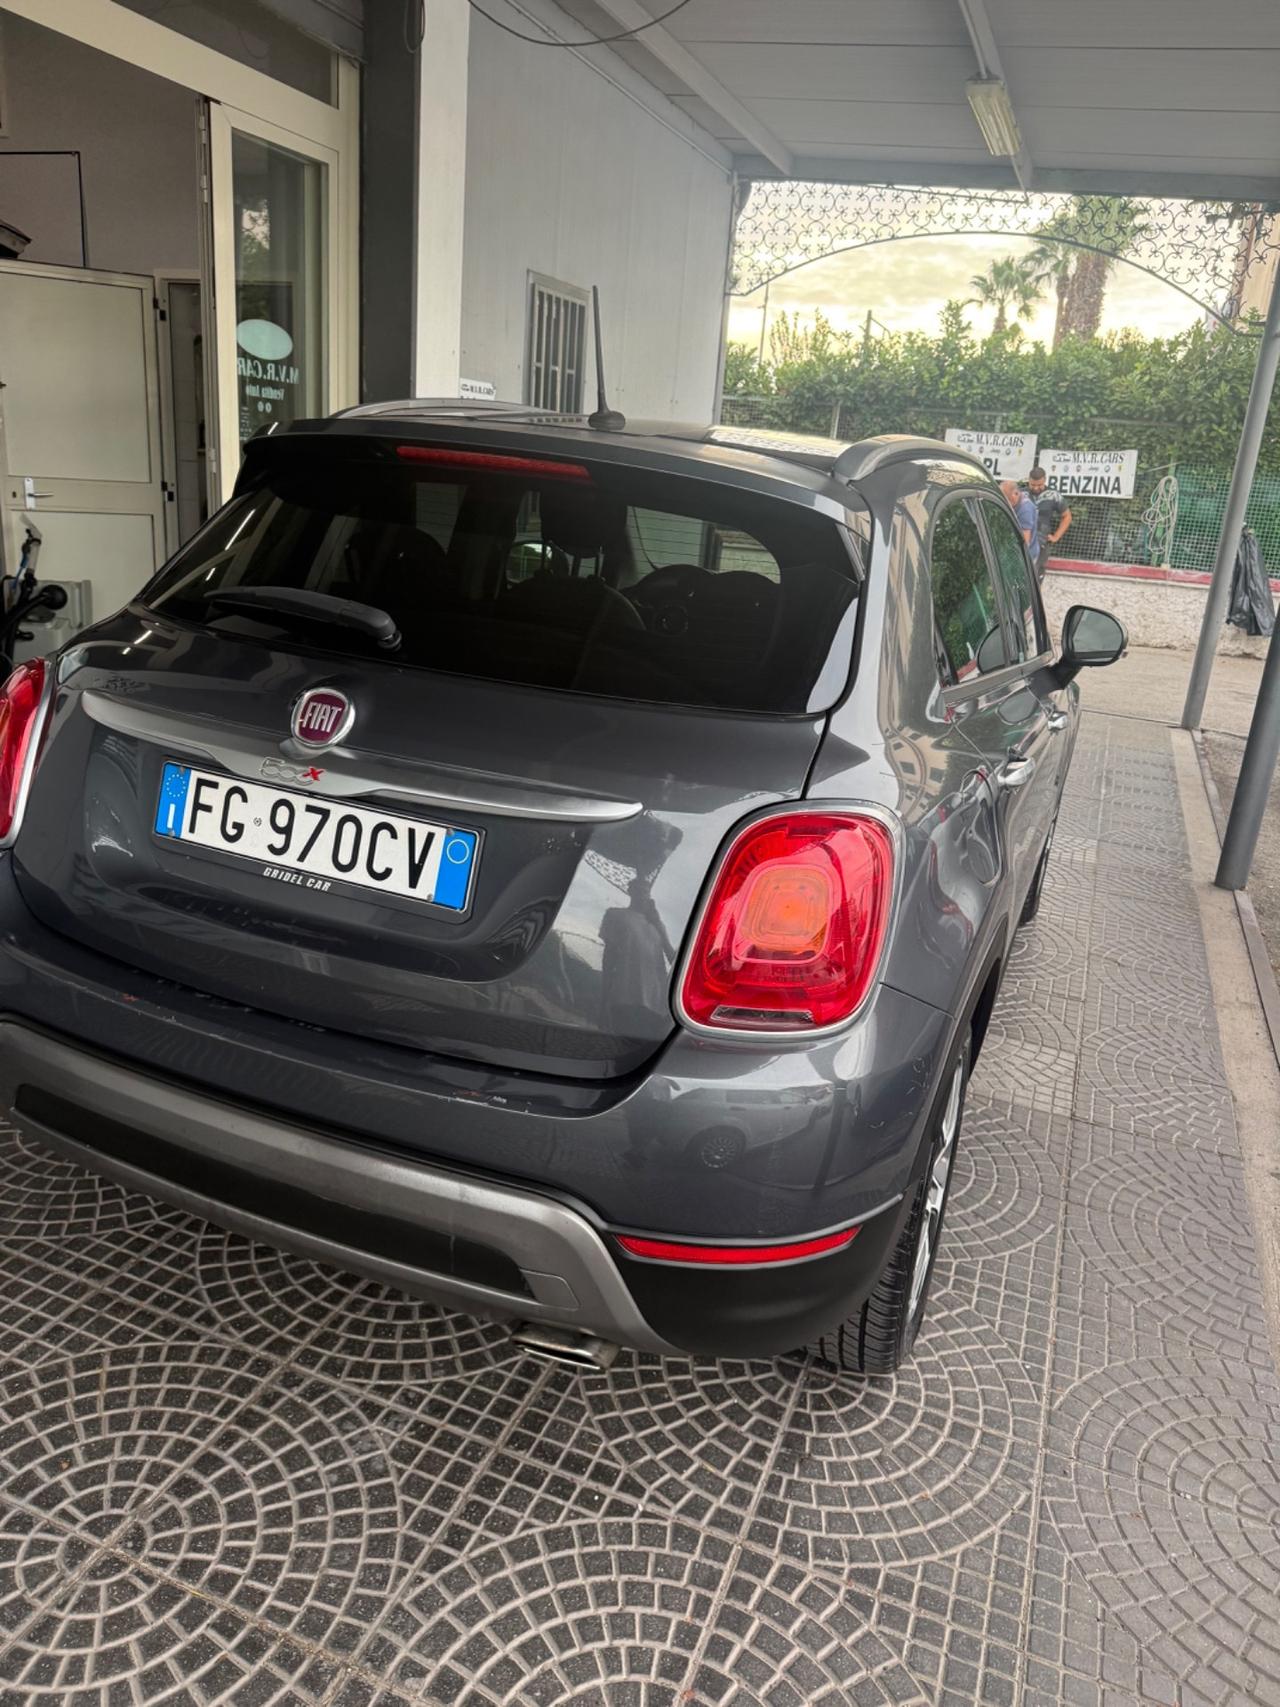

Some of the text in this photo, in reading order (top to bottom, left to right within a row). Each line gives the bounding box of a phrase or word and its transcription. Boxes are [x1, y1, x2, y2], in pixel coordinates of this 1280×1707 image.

[983, 457, 1001, 476] PL
[1049, 475, 1121, 495] BENZINA
[303, 702, 342, 733] FIAT
[188, 777, 435, 890] FG 970CV
[263, 866, 332, 893] GRIDEL CAR
